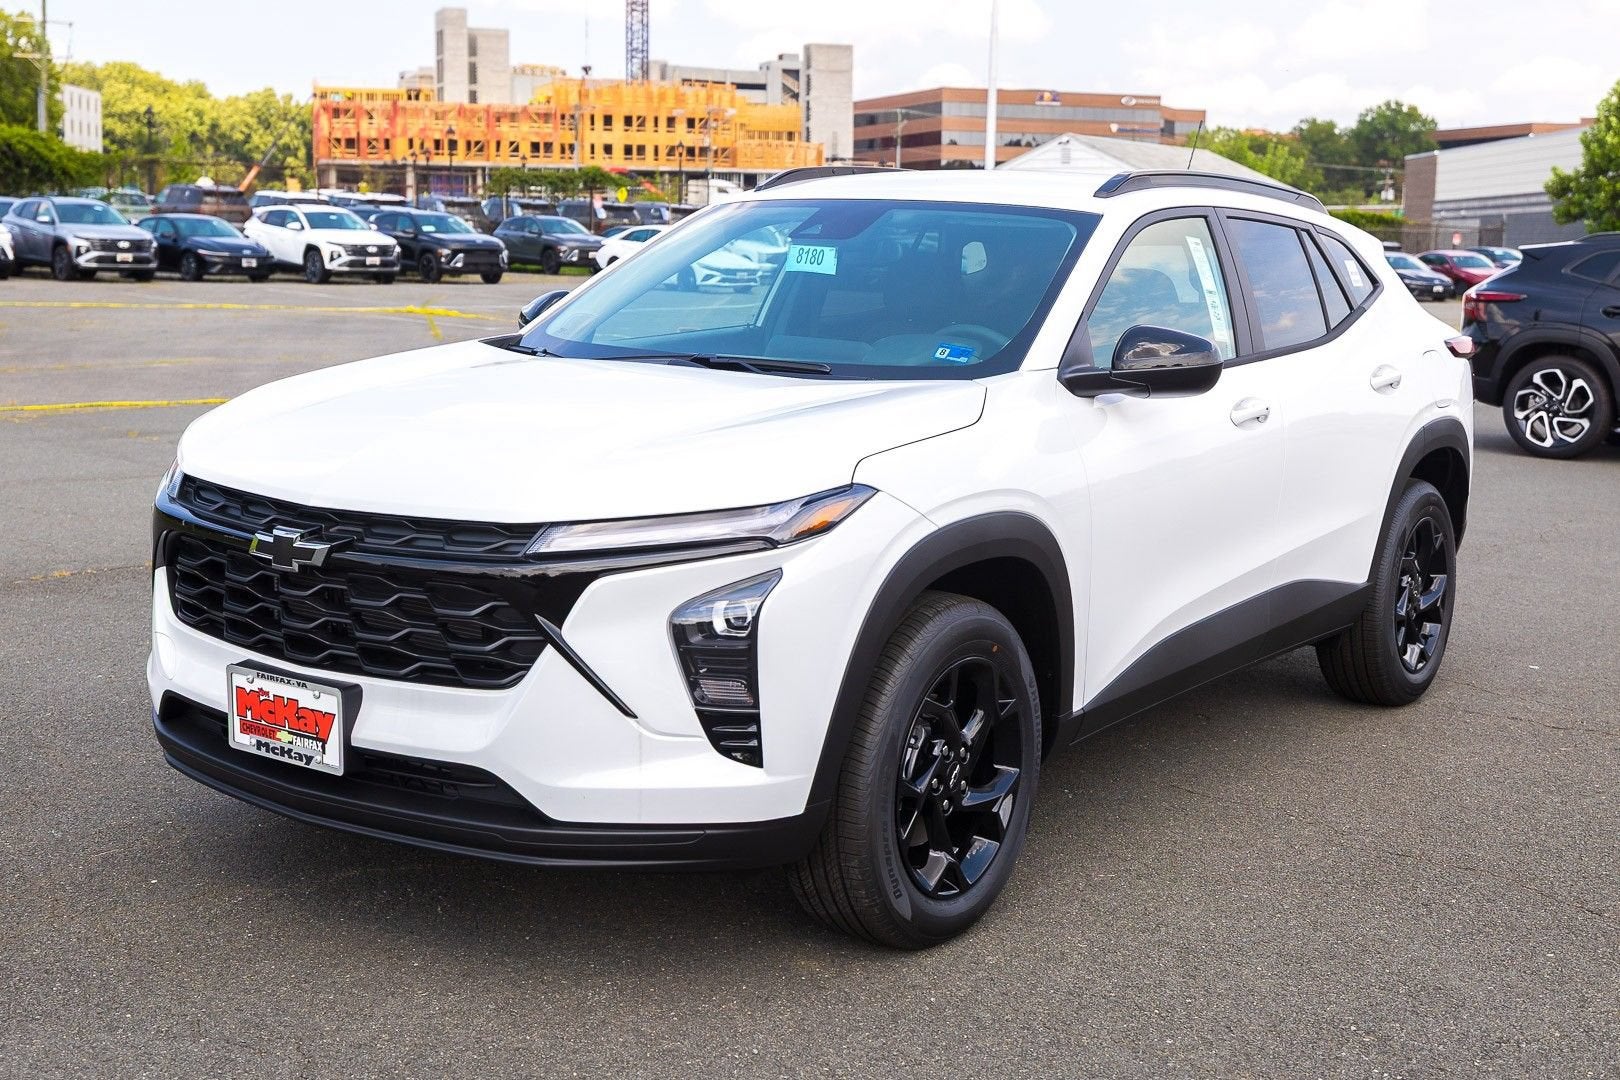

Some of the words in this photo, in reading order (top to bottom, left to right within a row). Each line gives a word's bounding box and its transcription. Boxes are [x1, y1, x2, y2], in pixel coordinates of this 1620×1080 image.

[796, 247, 825, 266] 8180
[236, 686, 336, 744] McKay
[242, 722, 277, 740] CHEVROLET
[256, 740, 314, 766] McKay
[293, 737, 323, 752] FAIRFAX
